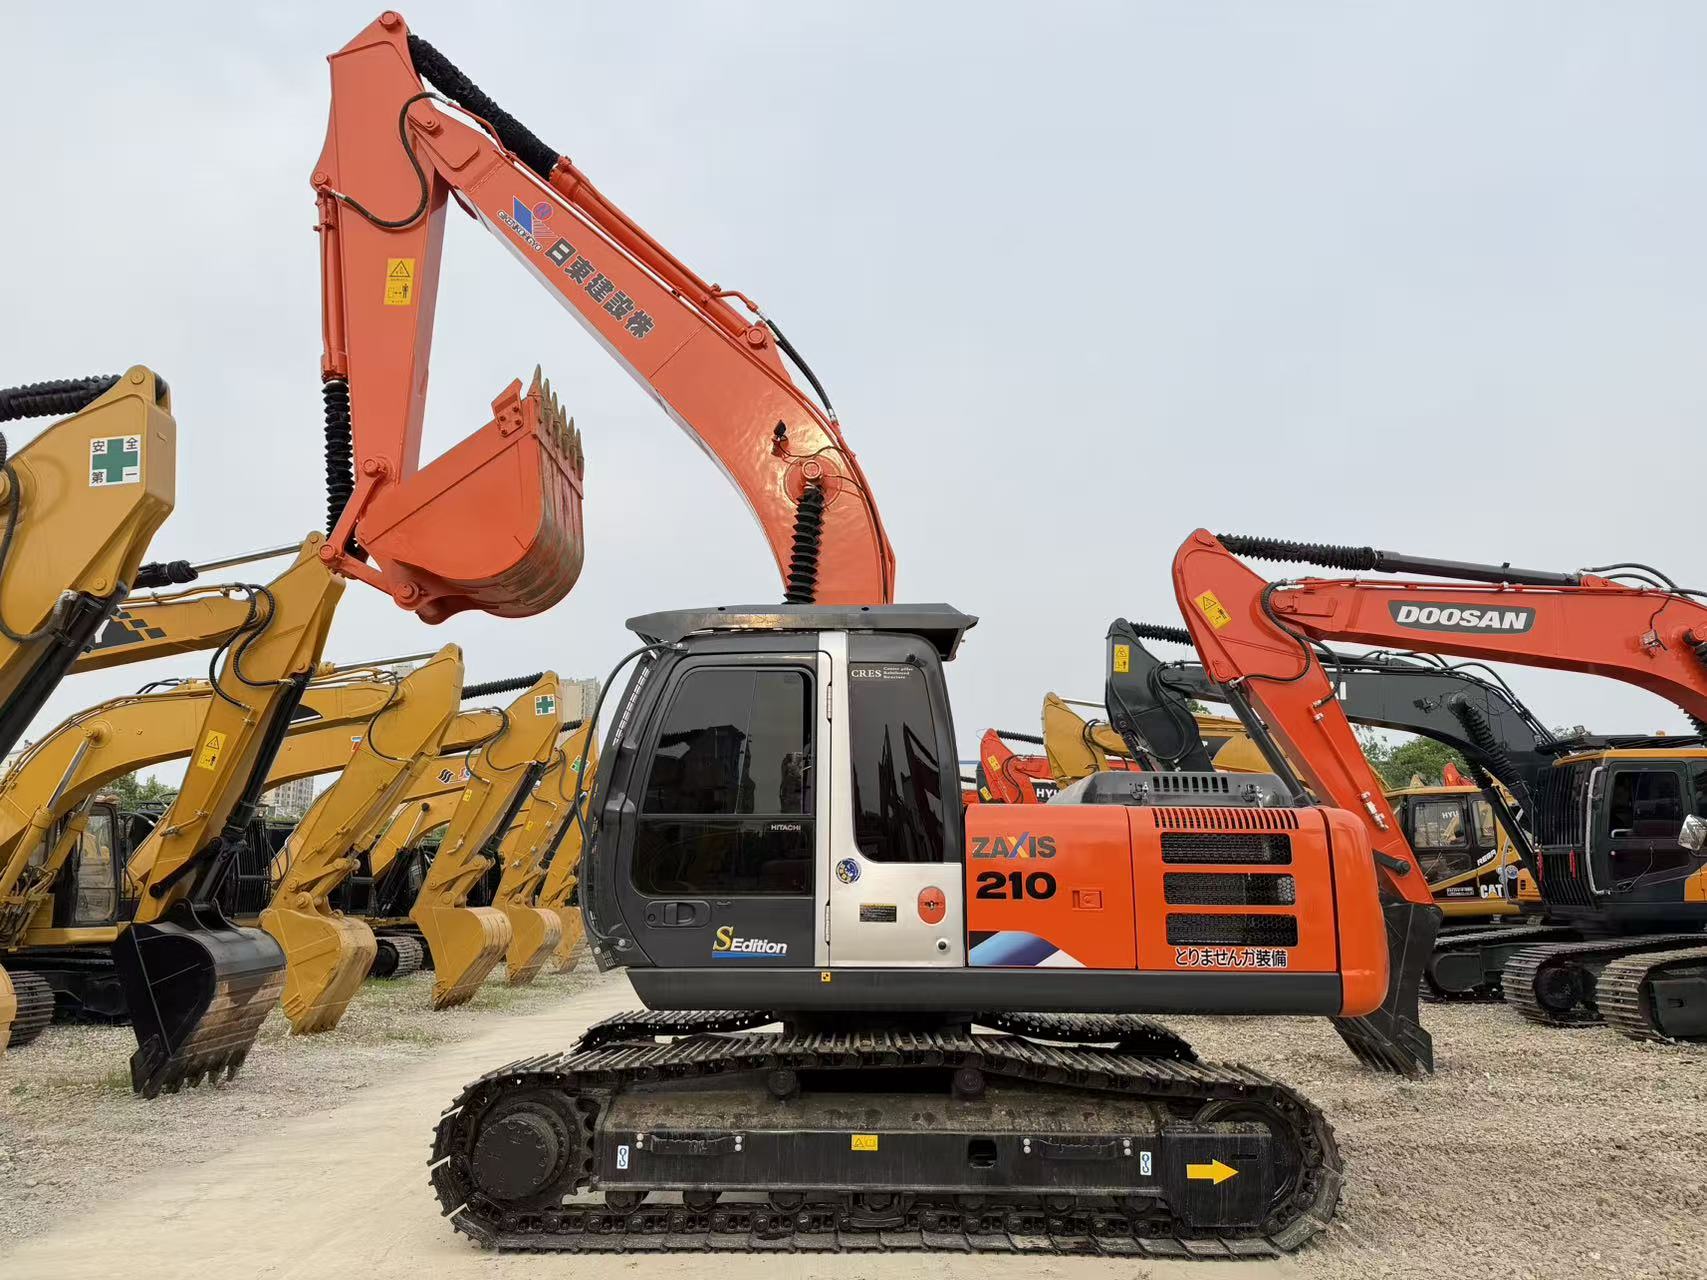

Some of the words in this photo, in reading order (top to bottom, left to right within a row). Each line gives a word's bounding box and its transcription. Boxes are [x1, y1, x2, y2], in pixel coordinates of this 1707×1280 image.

[544, 236, 655, 338] 日東建設株
[1397, 605, 1527, 629] DOOSAN
[851, 669, 882, 678] CRES
[971, 832, 1057, 859] ZAXIS
[976, 871, 1057, 900] 210
[1480, 884, 1503, 899] CAT
[730, 938, 788, 954] Edition
